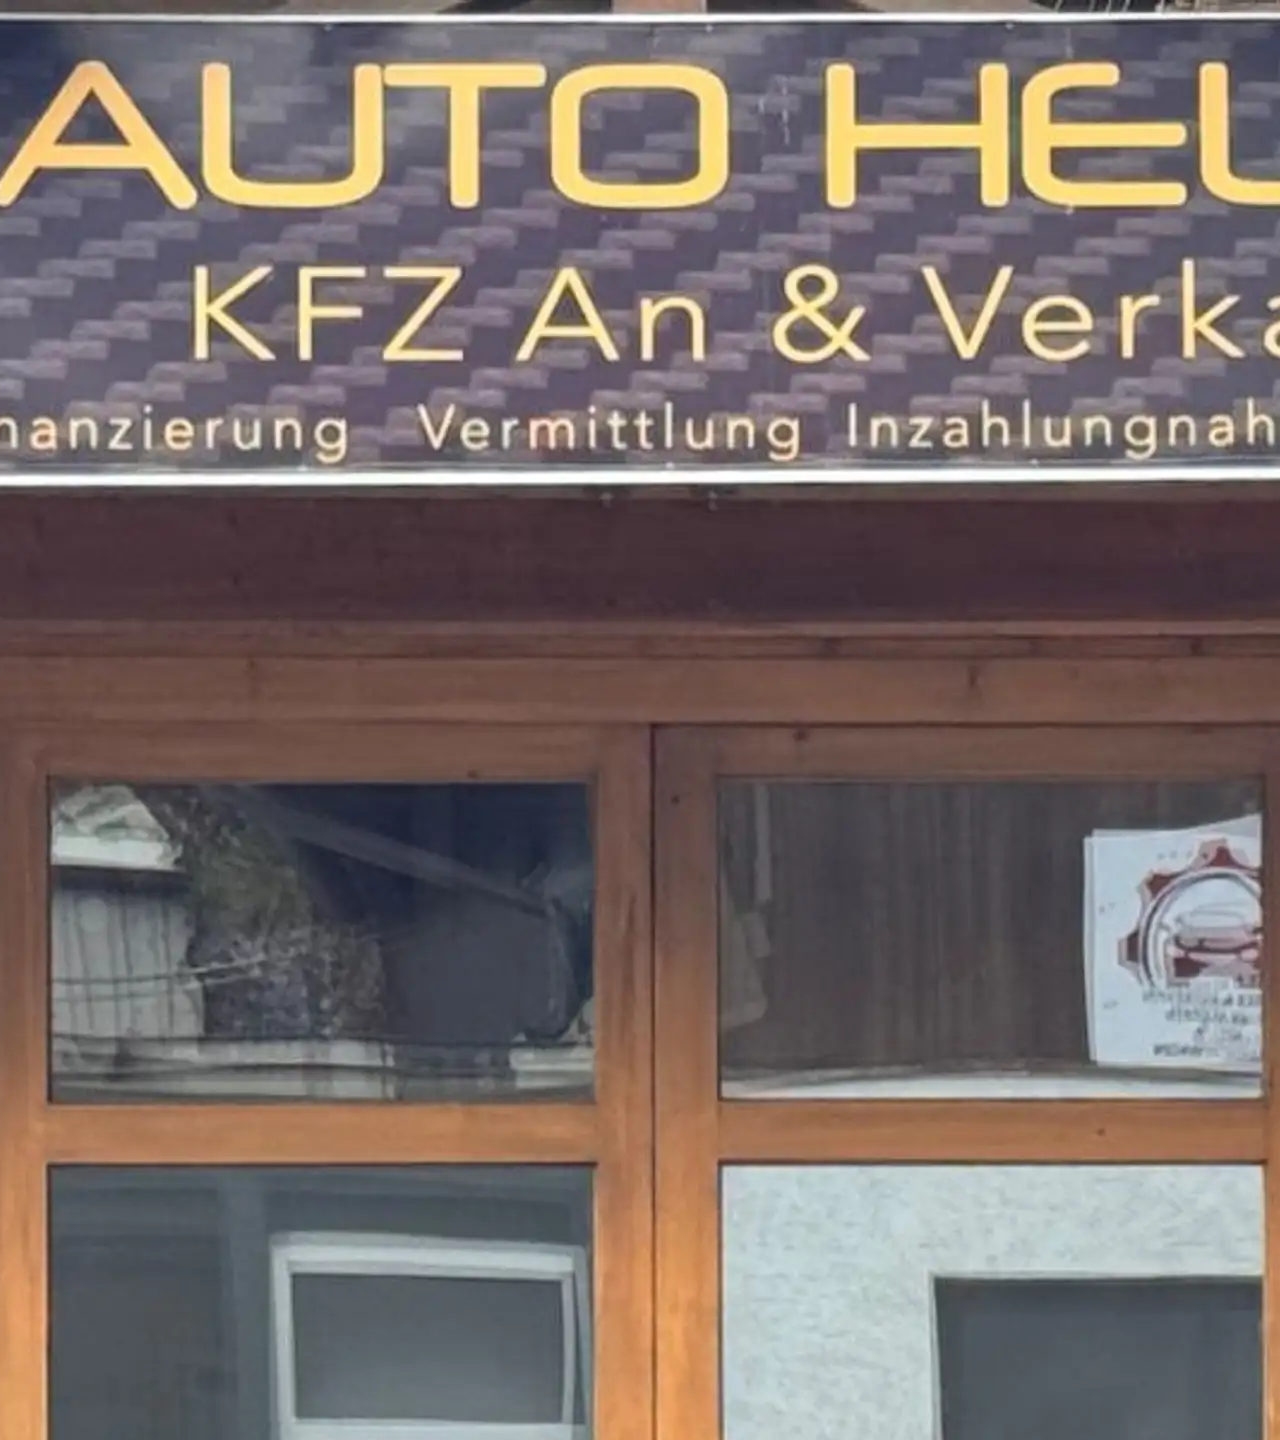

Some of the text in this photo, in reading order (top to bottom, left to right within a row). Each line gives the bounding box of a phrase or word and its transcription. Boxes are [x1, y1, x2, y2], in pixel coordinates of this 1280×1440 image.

[194, 264, 464, 363] KFZ
[516, 266, 706, 363] An
[771, 263, 871, 364] &
[418, 401, 801, 462] Vermittlung
